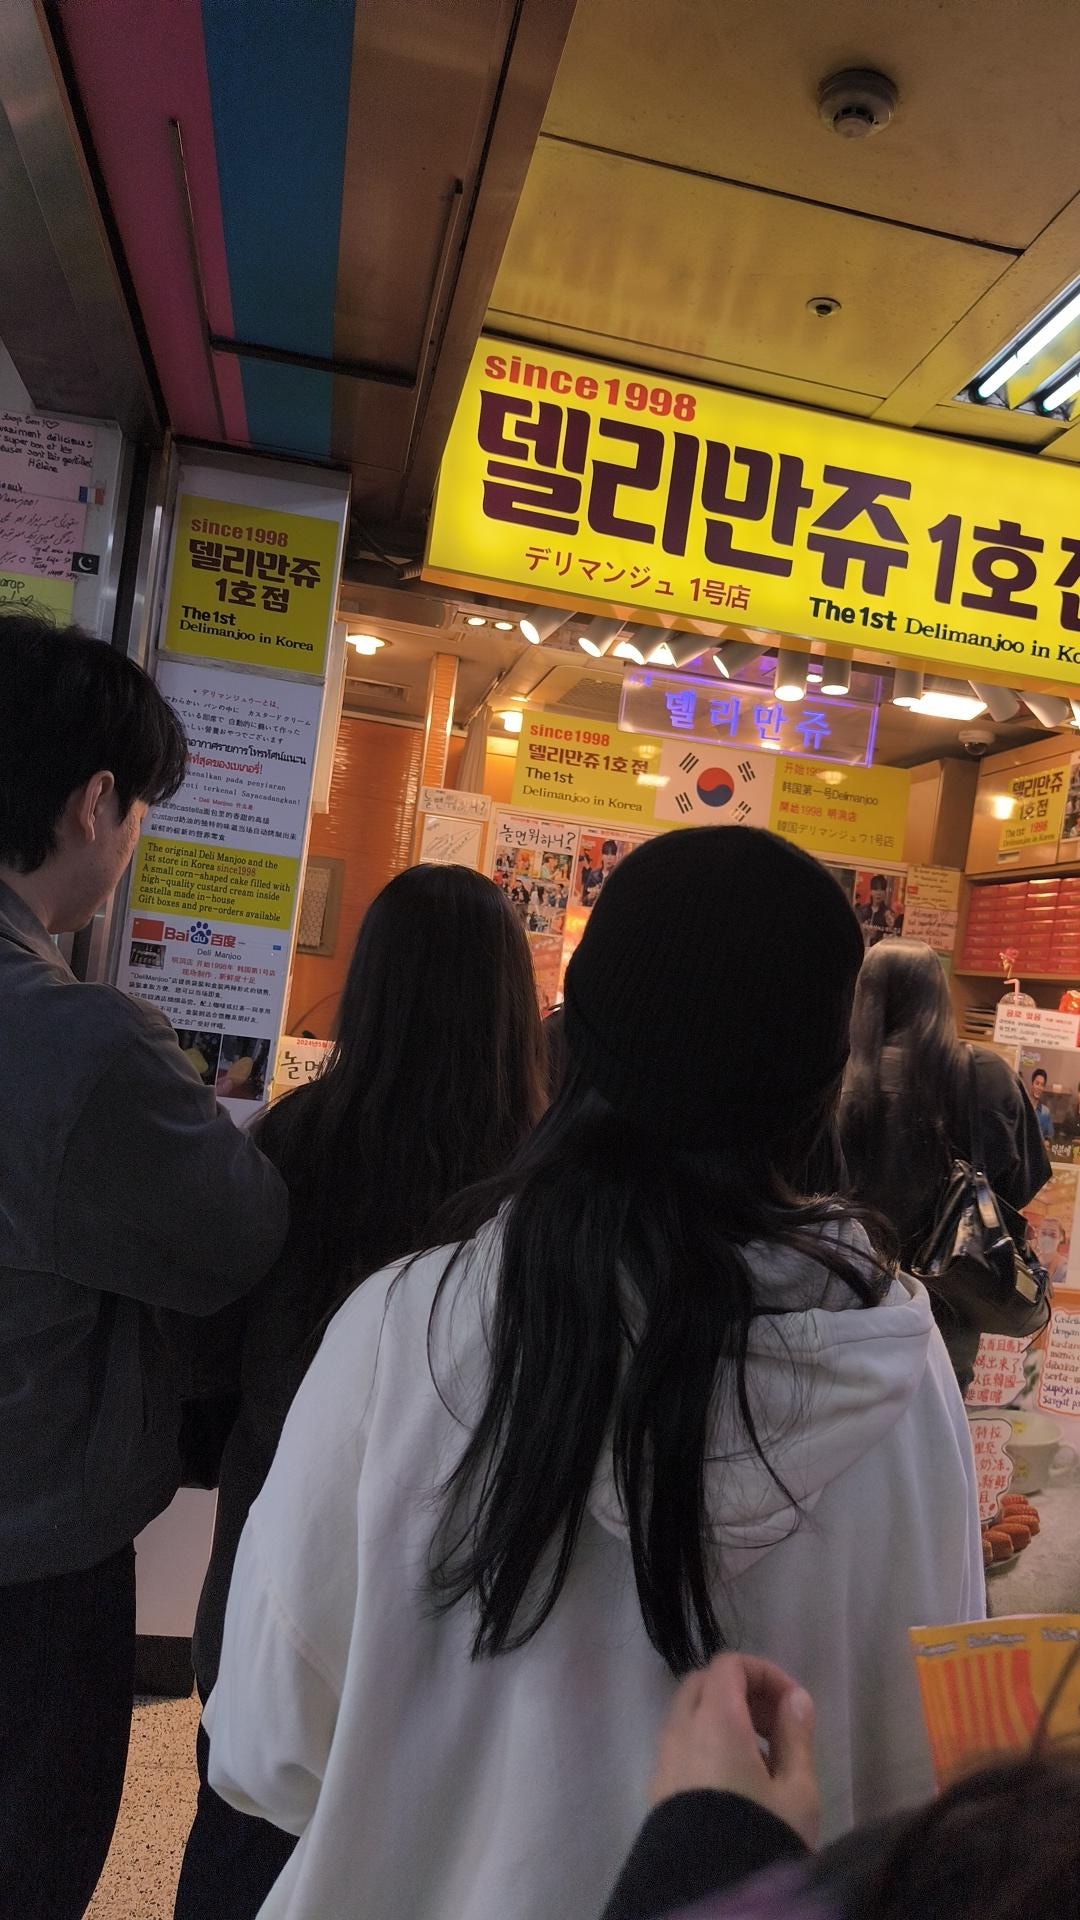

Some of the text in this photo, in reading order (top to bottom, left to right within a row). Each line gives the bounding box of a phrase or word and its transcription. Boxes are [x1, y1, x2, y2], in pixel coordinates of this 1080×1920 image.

[485, 355, 697, 422] since1998
[477, 389, 912, 597] 델리만쥬
[189, 538, 321, 589] 델리만쥬
[525, 546, 751, 610] デリマンジュ 1号店
[215, 577, 290, 614] 1호점
[180, 619, 314, 651] Delimanjoo in Korea
[905, 617, 1024, 653] Delimanjoo
[1031, 639, 1050, 658] in
[522, 784, 643, 812] Delimanjoo in Korea
[144, 853, 156, 862] 1st
[158, 855, 178, 865] store
[180, 858, 189, 867] in
[191, 859, 215, 871] Korea
[148, 842, 279, 870] The original Deli Manjoo and the
[139, 884, 169, 896] castella
[174, 889, 195, 900] made
[142, 863, 149, 872] A
[151, 865, 174, 875] small
[230, 877, 249, 887] cake
[251, 878, 271, 890] filled
[273, 883, 291, 893] with
[197, 883, 228, 895] custard
[229, 887, 254, 898] cream
[256, 890, 280, 902] inside
[138, 893, 155, 905] Gift
[157, 896, 180, 909] boxes
[182, 901, 197, 911] and
[245, 910, 281, 922] available
[165, 927, 190, 942] Bai
[211, 933, 237, 948] 百度
[197, 948, 242, 961] Deli Manjoo
